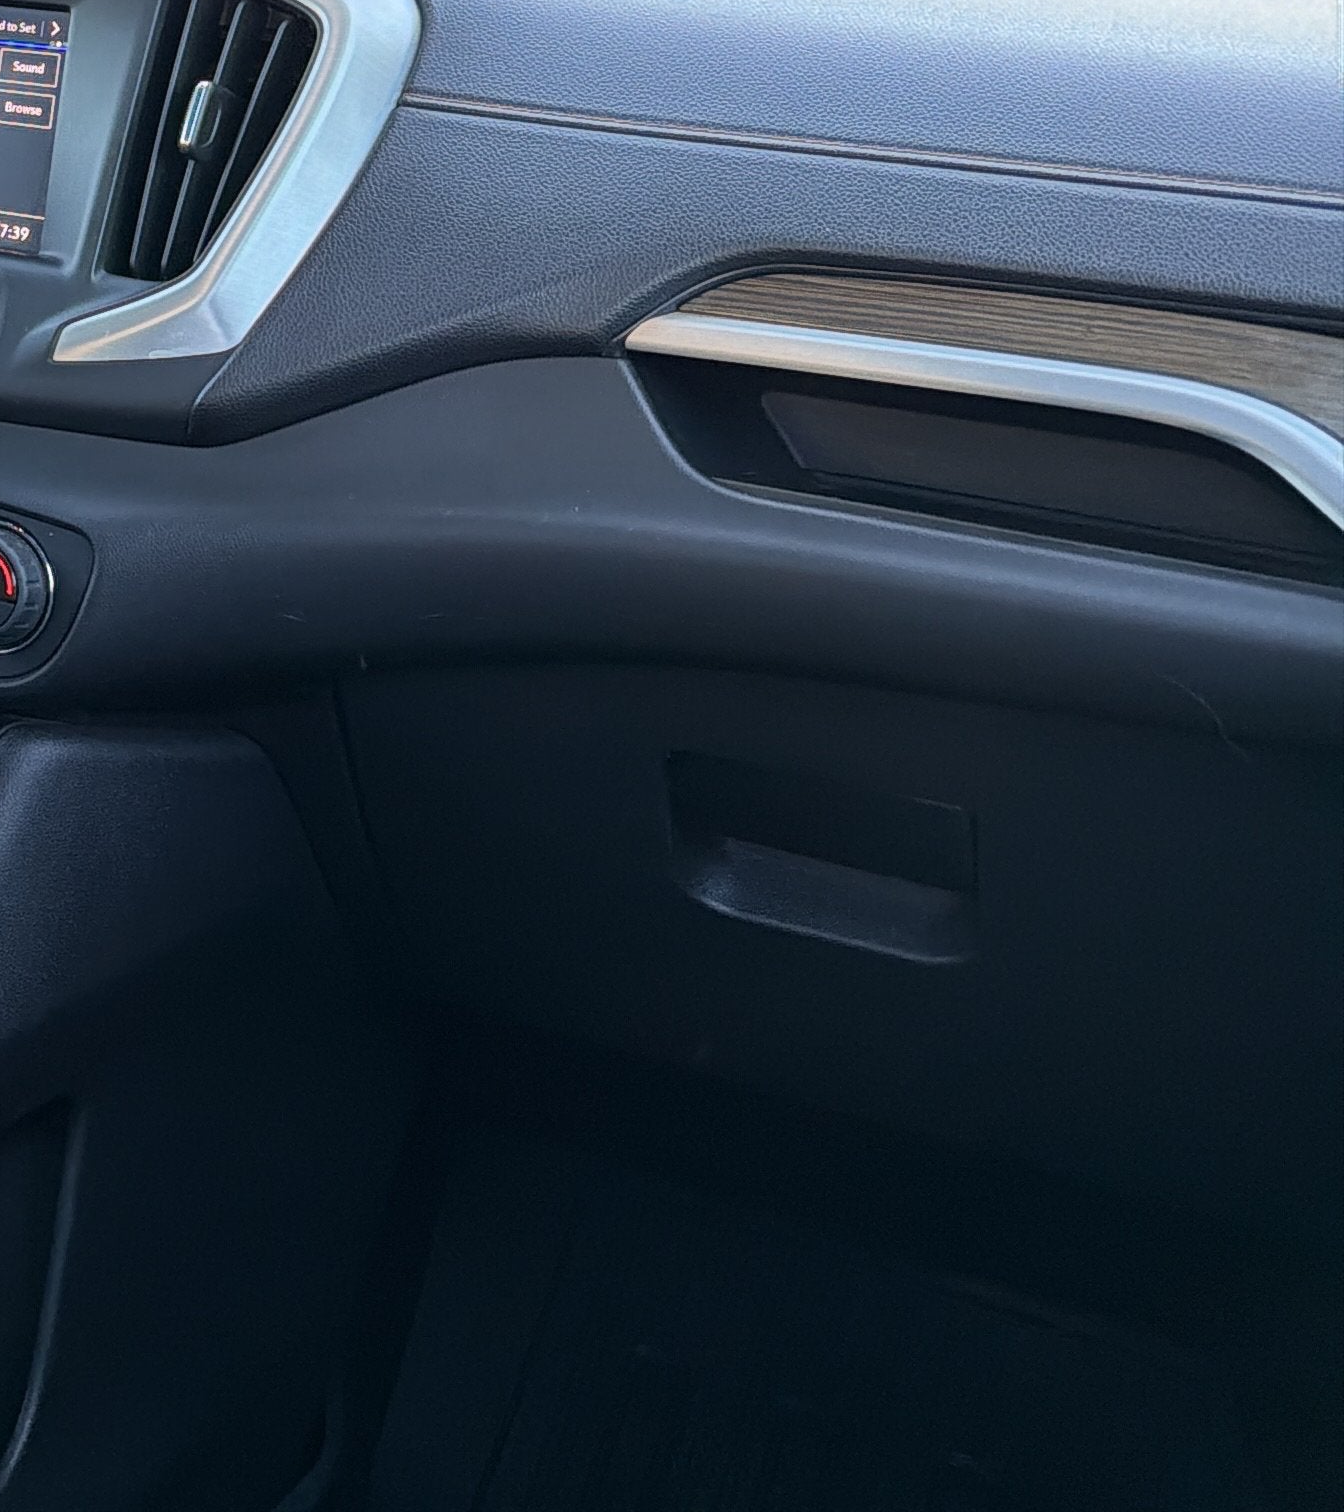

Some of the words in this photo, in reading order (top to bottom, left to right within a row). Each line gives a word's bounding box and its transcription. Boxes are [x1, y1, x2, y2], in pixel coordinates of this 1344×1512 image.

[6, 21, 18, 32] to
[20, 22, 37, 34] Set
[12, 60, 46, 75] Sound
[4, 100, 43, 117] Browse
[0, 222, 30, 242] 7:39
